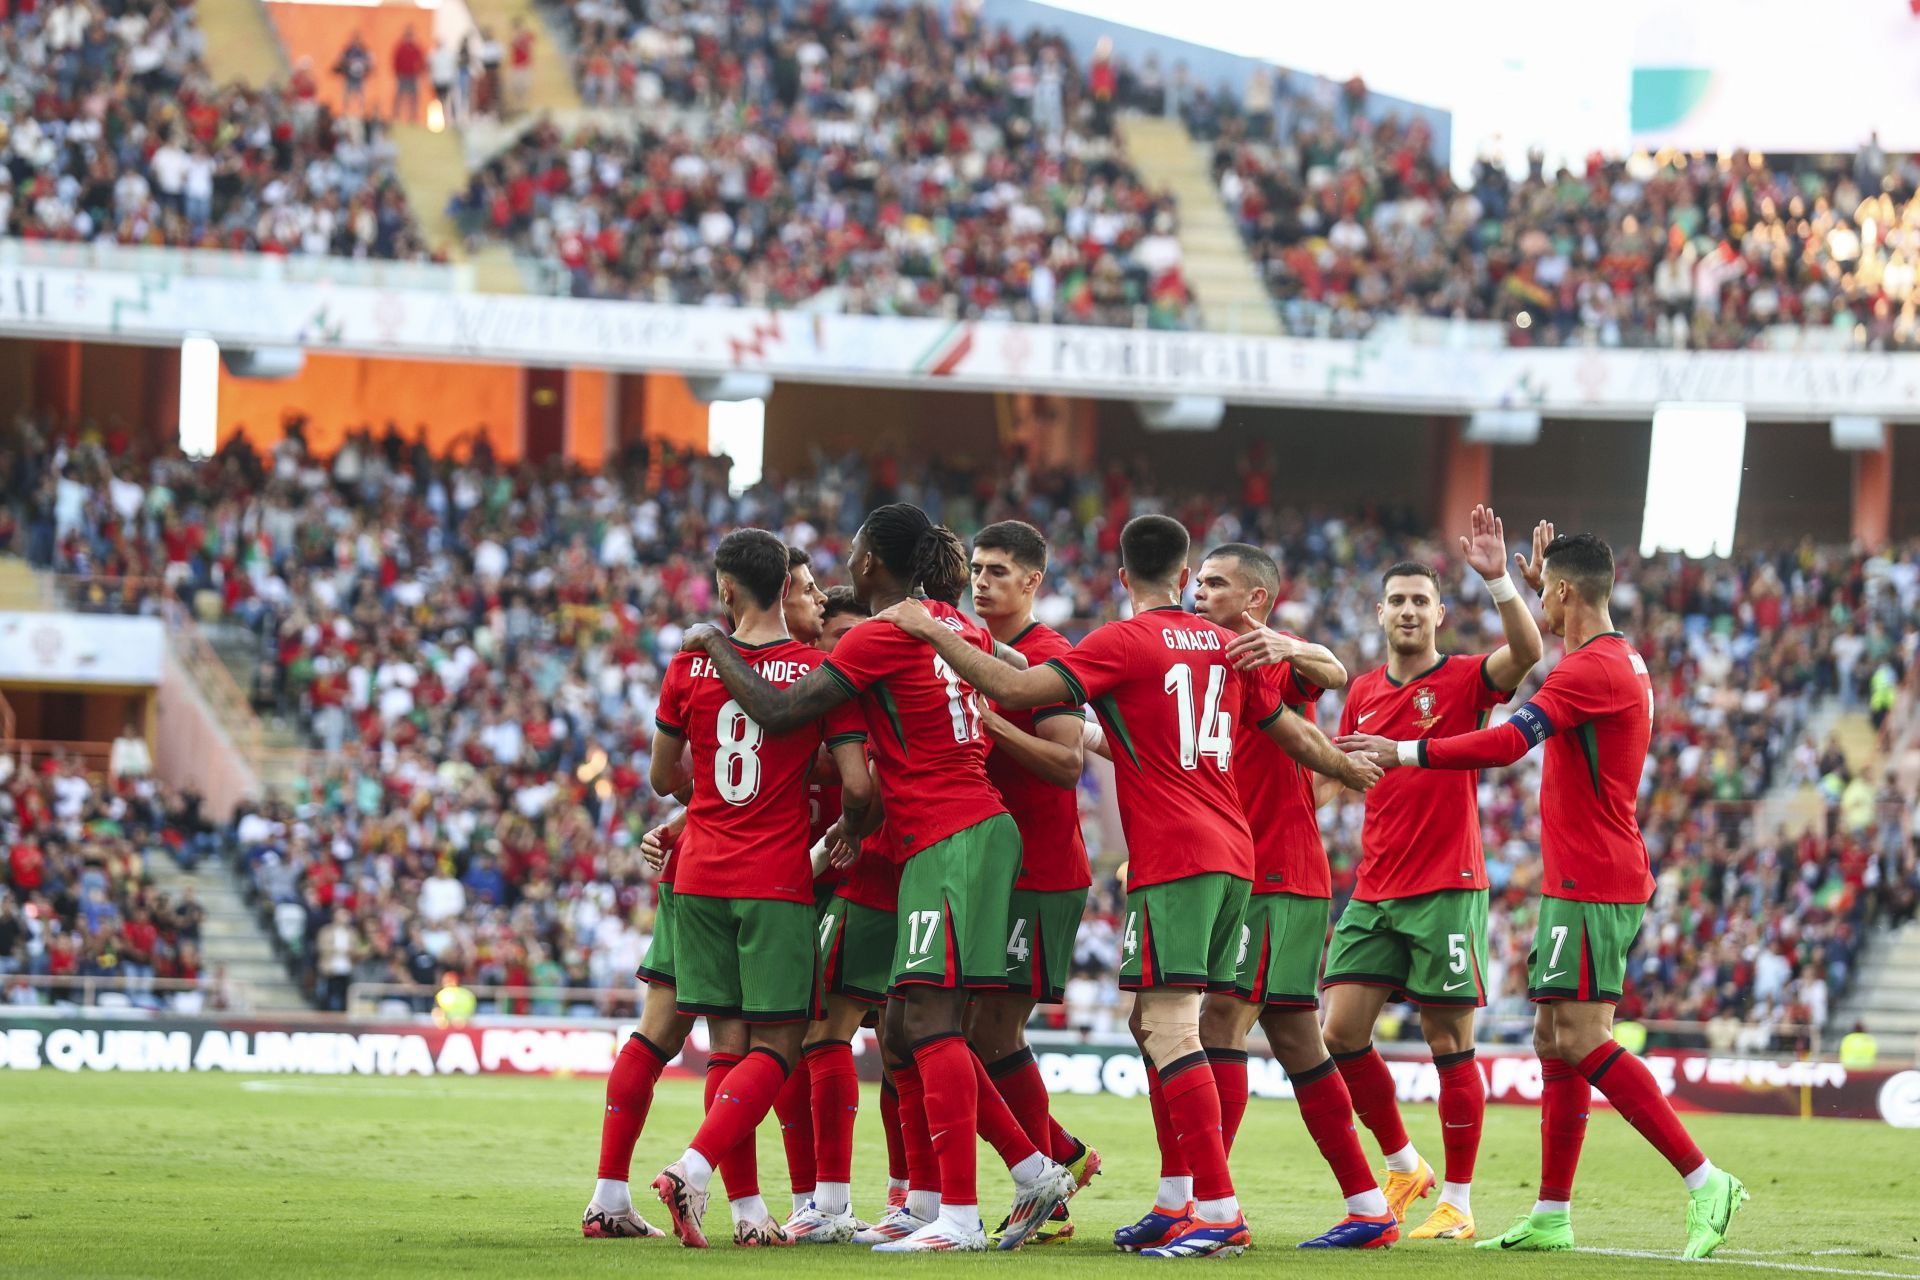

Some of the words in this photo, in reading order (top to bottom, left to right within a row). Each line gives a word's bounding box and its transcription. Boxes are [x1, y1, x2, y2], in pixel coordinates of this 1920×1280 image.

[1162, 628, 1221, 650] G.INÁCIO
[1165, 663, 1232, 772] 14
[714, 699, 764, 807] 8
[908, 910, 941, 954] 17
[1006, 918, 1029, 962] 4
[1448, 933, 1468, 975] 5
[1548, 925, 1568, 969] 7
[45, 1030, 192, 1073] QUEM
[197, 1030, 433, 1075] ALIMENTA
[436, 1033, 479, 1075] A
[481, 1029, 616, 1072] FOME
